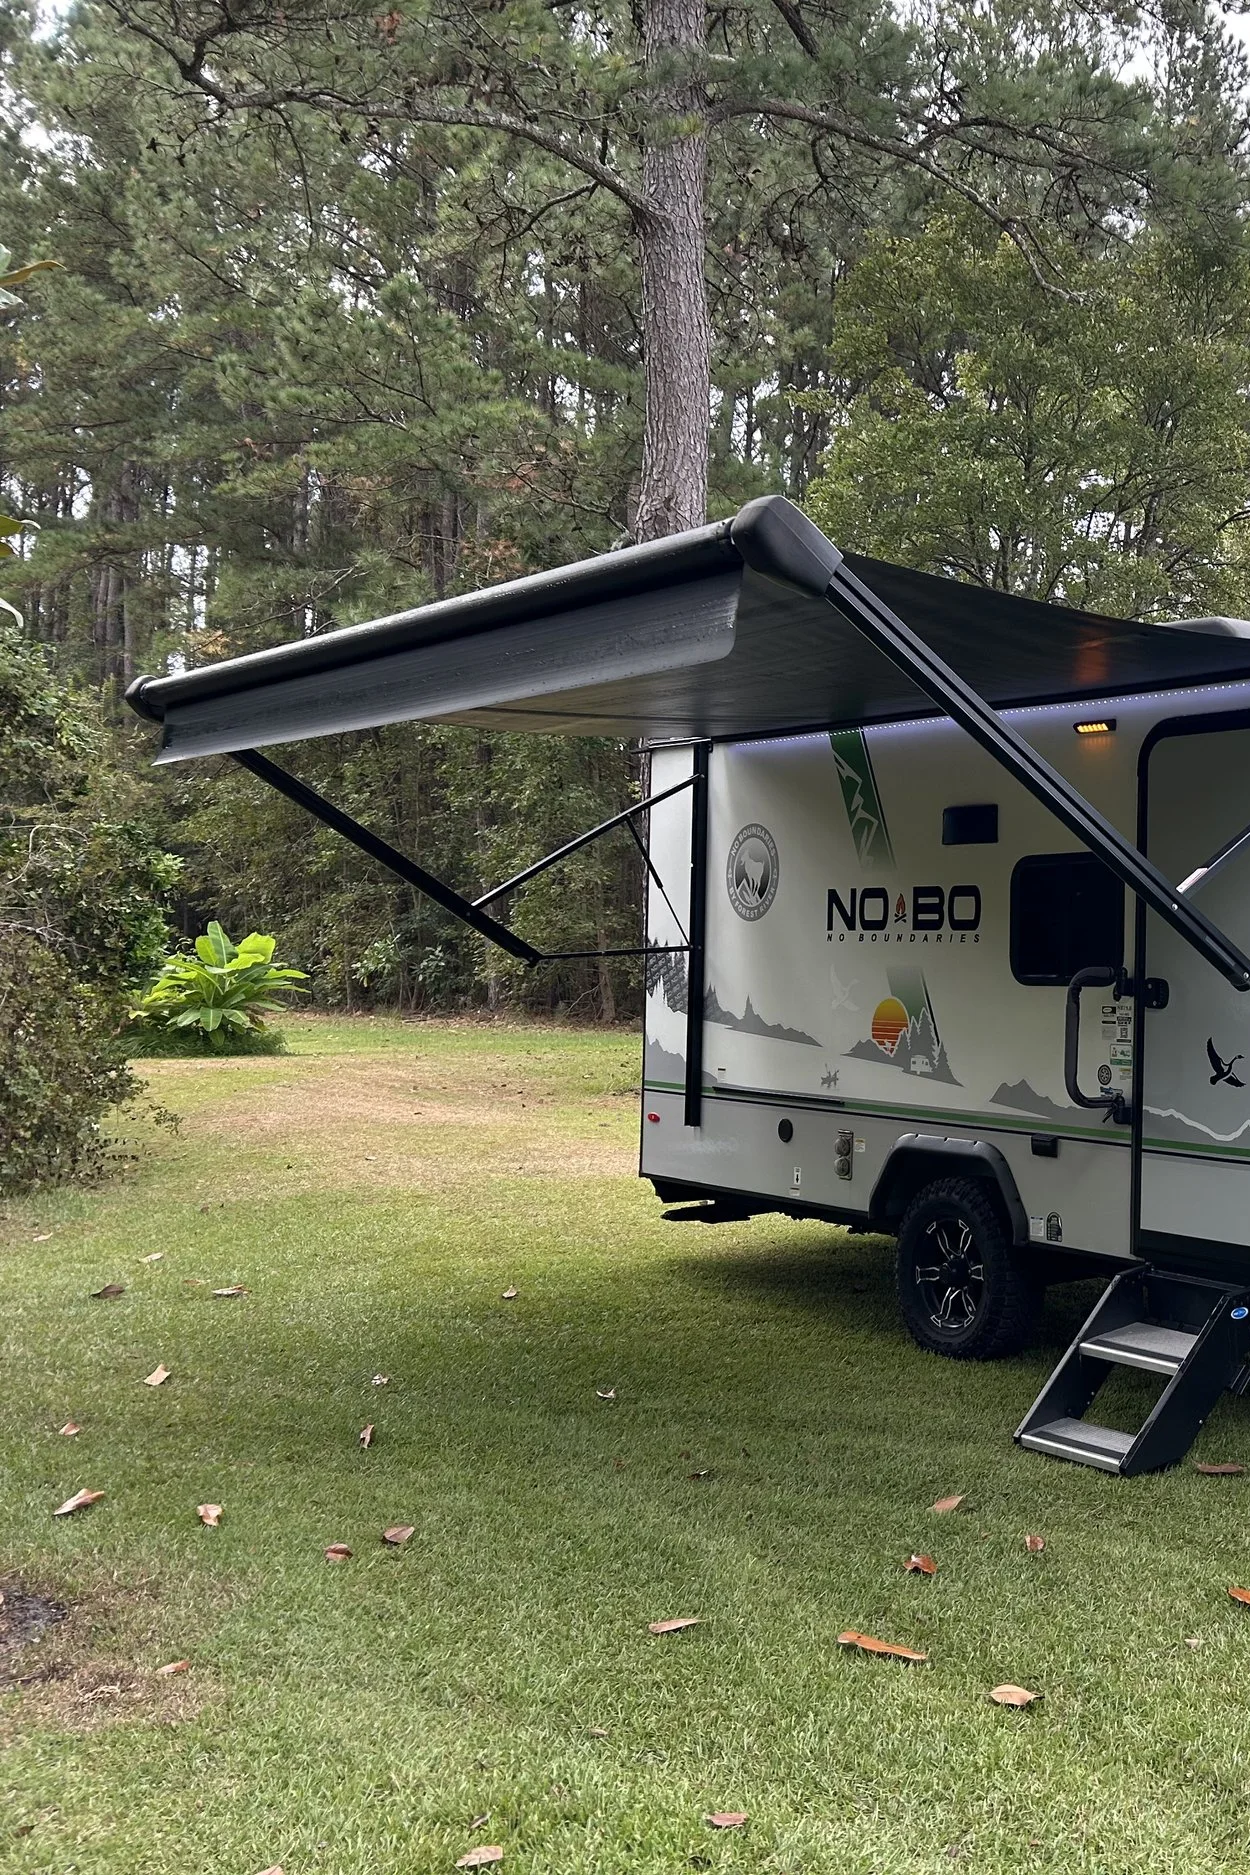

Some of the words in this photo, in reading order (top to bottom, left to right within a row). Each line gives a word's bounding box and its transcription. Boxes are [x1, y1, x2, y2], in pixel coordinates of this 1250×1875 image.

[730, 840, 740, 856] NO
[738, 826, 776, 857] BOUNDARIES
[729, 886, 737, 900] BY
[734, 901, 758, 918] FOREST
[826, 933, 845, 942] NO
[858, 933, 980, 943] BOUNDARIES
